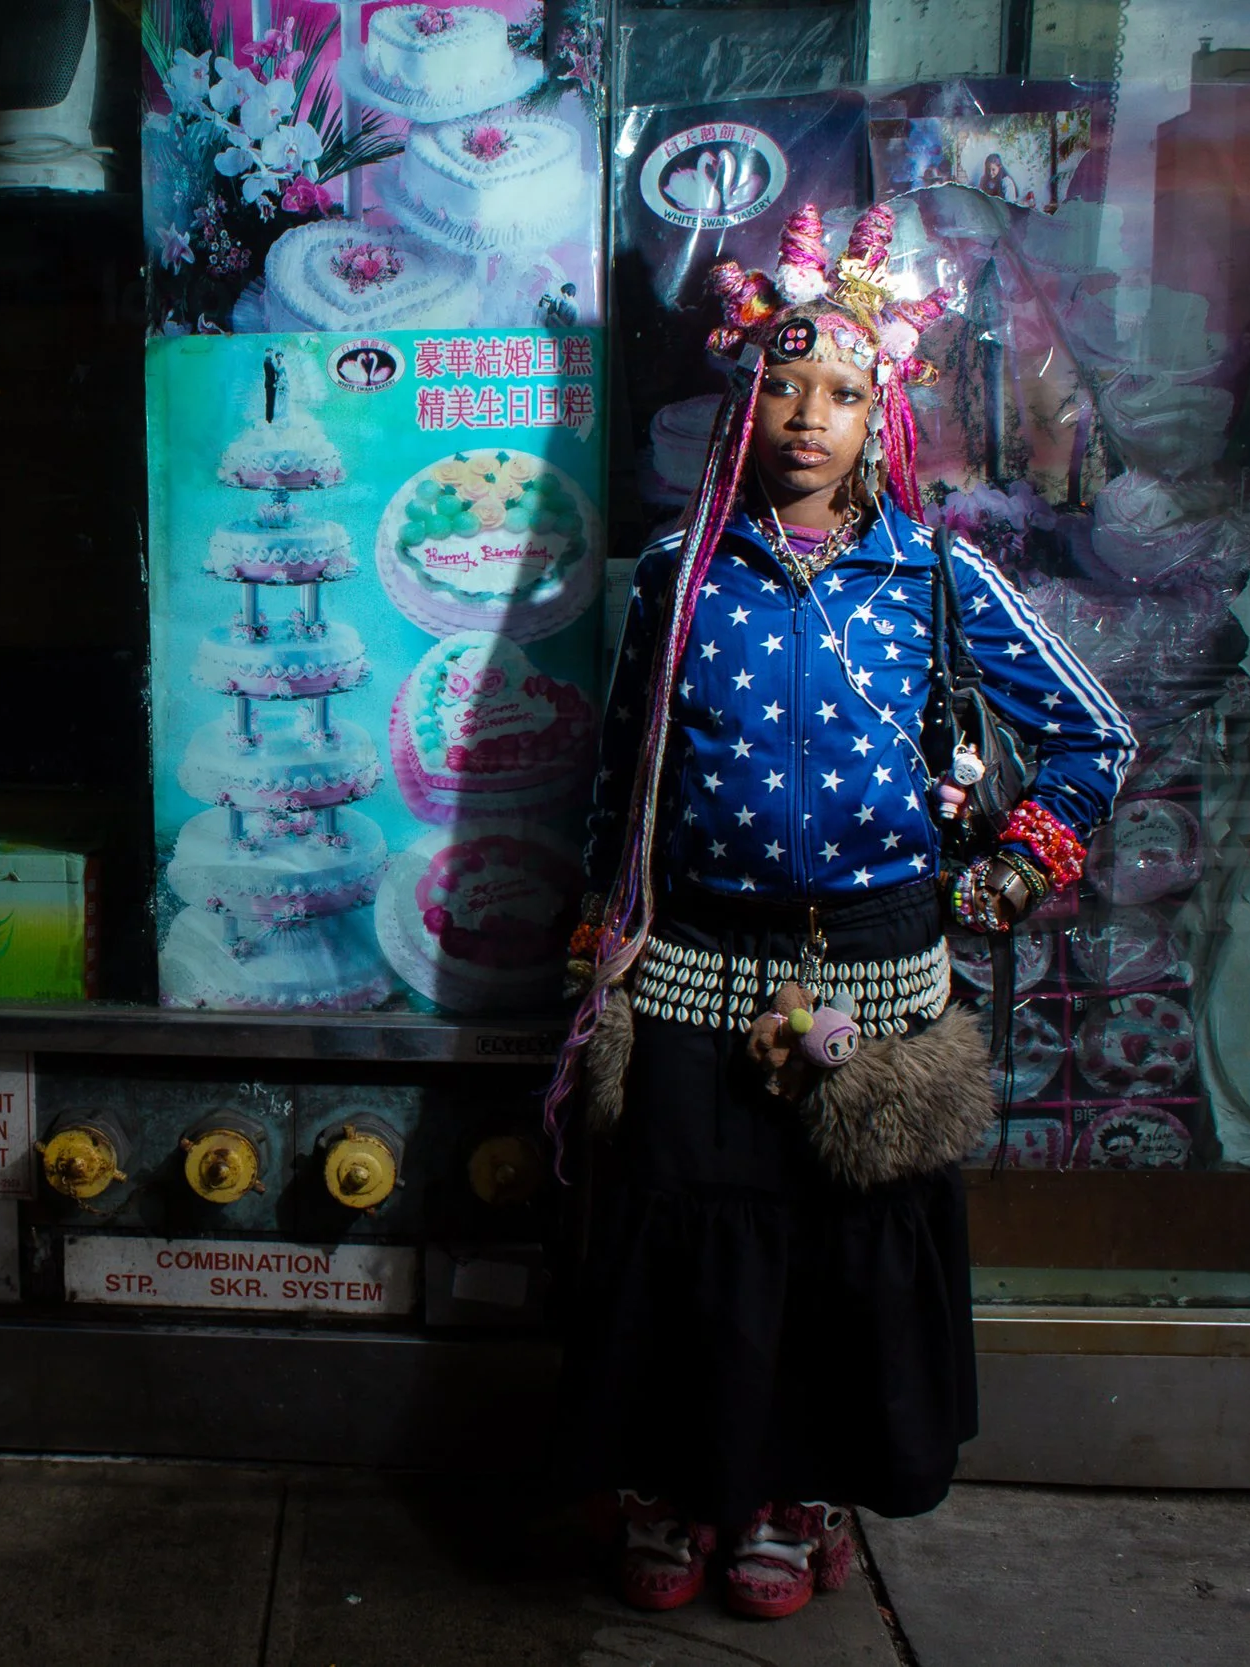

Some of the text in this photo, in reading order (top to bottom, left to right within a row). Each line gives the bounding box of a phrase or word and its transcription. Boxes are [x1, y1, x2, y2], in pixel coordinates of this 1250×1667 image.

[663, 208, 698, 227] WHITE
[414, 336, 593, 378] 豪華結婚旦糕
[338, 379, 355, 390] WHITE
[416, 385, 594, 430] 精美生日旦糕
[156, 1250, 331, 1274] COMBINATION
[210, 1278, 269, 1297] SKR.
[282, 1280, 383, 1301] SYSTEM
